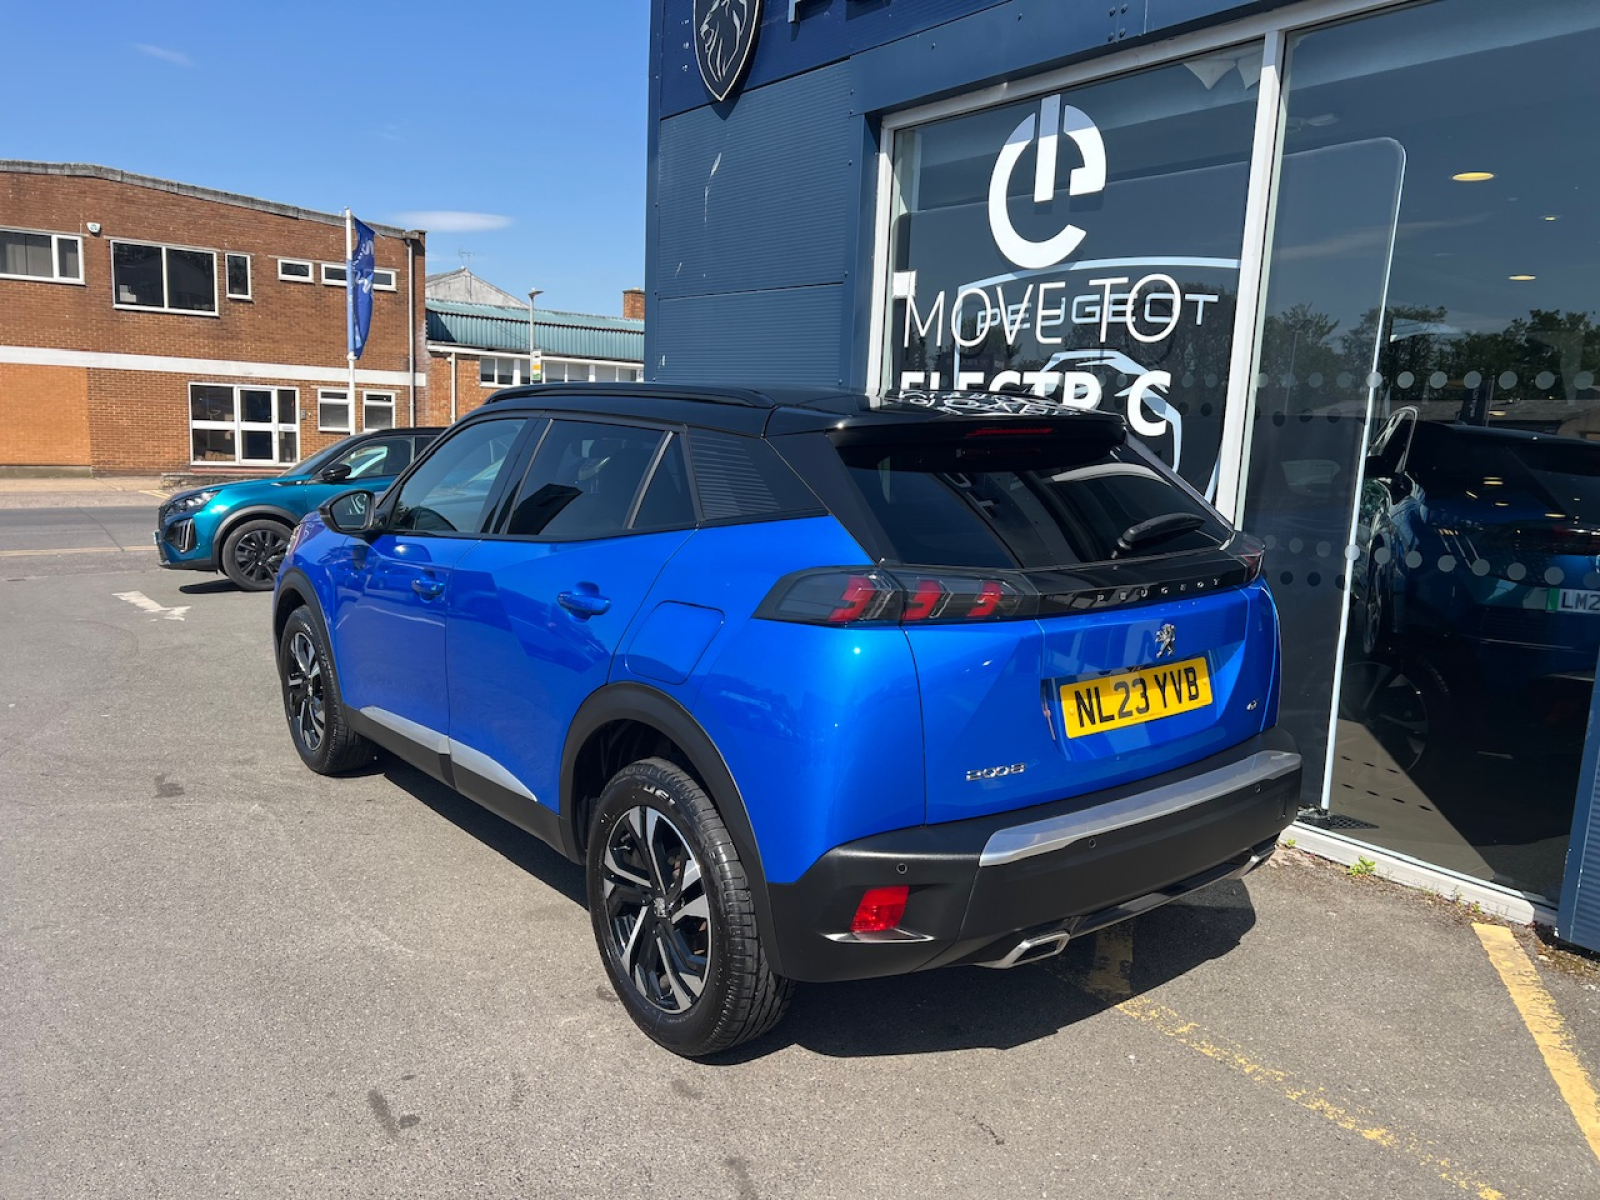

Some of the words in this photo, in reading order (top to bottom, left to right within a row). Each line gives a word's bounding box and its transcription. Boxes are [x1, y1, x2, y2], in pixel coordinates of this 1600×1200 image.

[903, 281, 1066, 348] MOVE
[1088, 273, 1182, 344] TO
[975, 293, 1219, 338] PEUGEOT
[1096, 577, 1220, 602] PEUGEOT
[1074, 677, 1150, 728] NL23
[1154, 666, 1199, 709] YVB
[965, 762, 1026, 781] 2008
